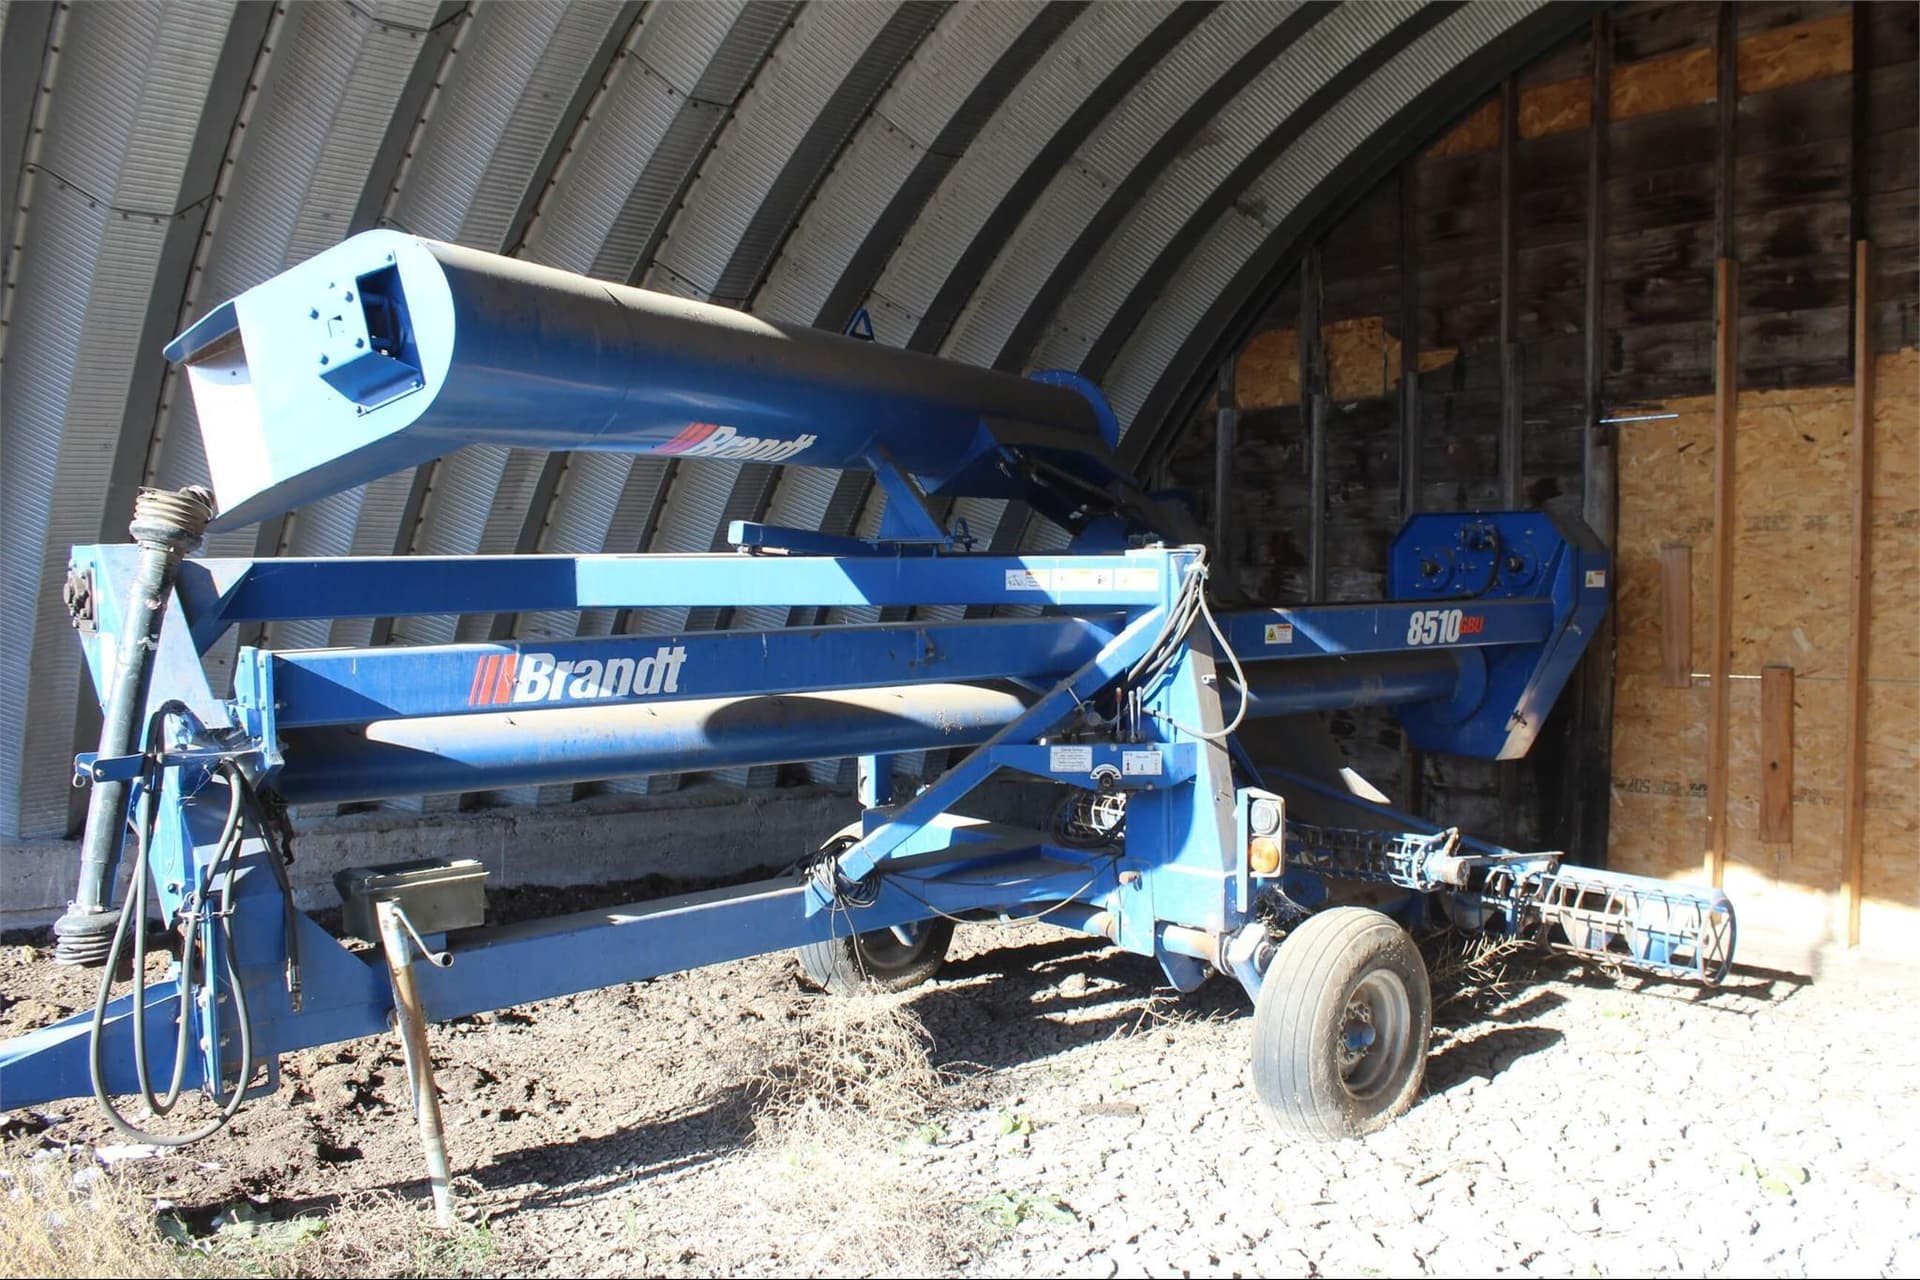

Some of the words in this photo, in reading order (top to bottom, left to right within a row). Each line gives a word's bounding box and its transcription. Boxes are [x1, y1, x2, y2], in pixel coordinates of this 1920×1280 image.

[679, 425, 818, 461] Brandt
[1407, 609, 1462, 645] 8510
[512, 646, 687, 703] Brandt
